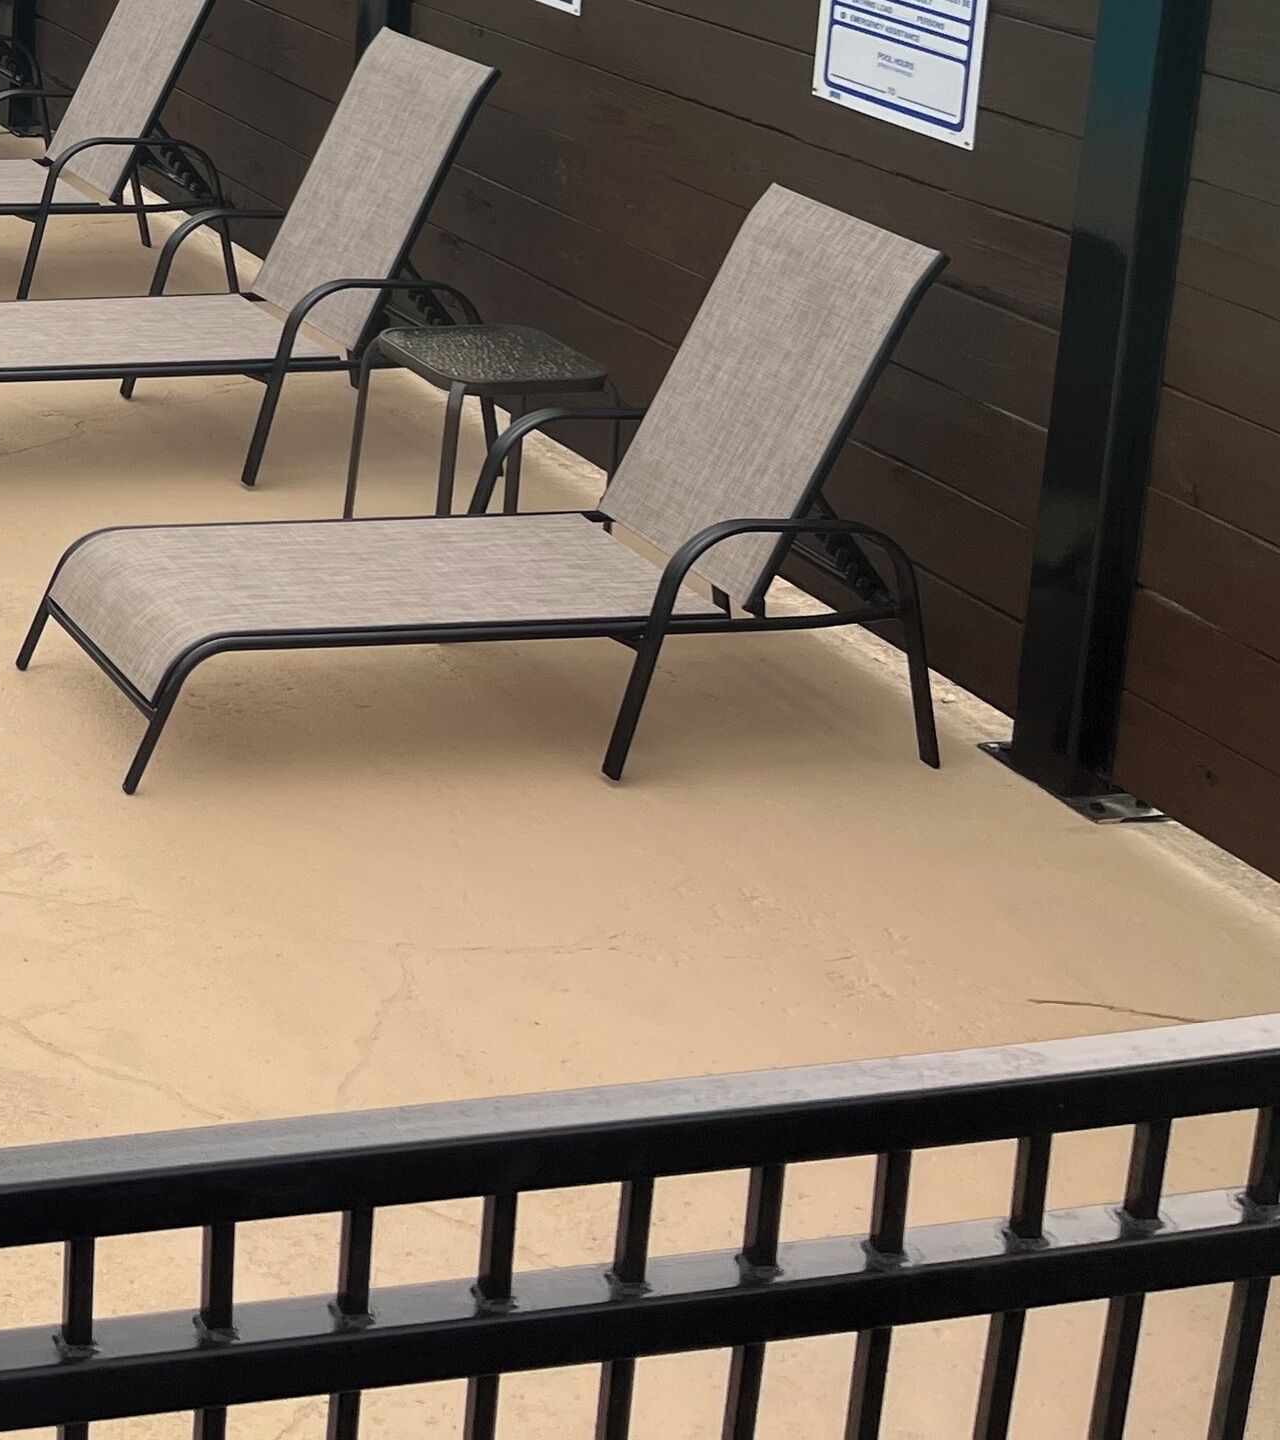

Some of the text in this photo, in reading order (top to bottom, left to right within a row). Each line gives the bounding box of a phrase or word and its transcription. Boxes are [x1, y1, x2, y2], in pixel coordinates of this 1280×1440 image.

[850, 14, 919, 42] EMERGENCY ASSISTANCE
[876, 3, 892, 14] LOAD
[916, 16, 943, 30] PERSONS
[877, 52, 894, 64] POOL
[895, 57, 913, 70] HOURS
